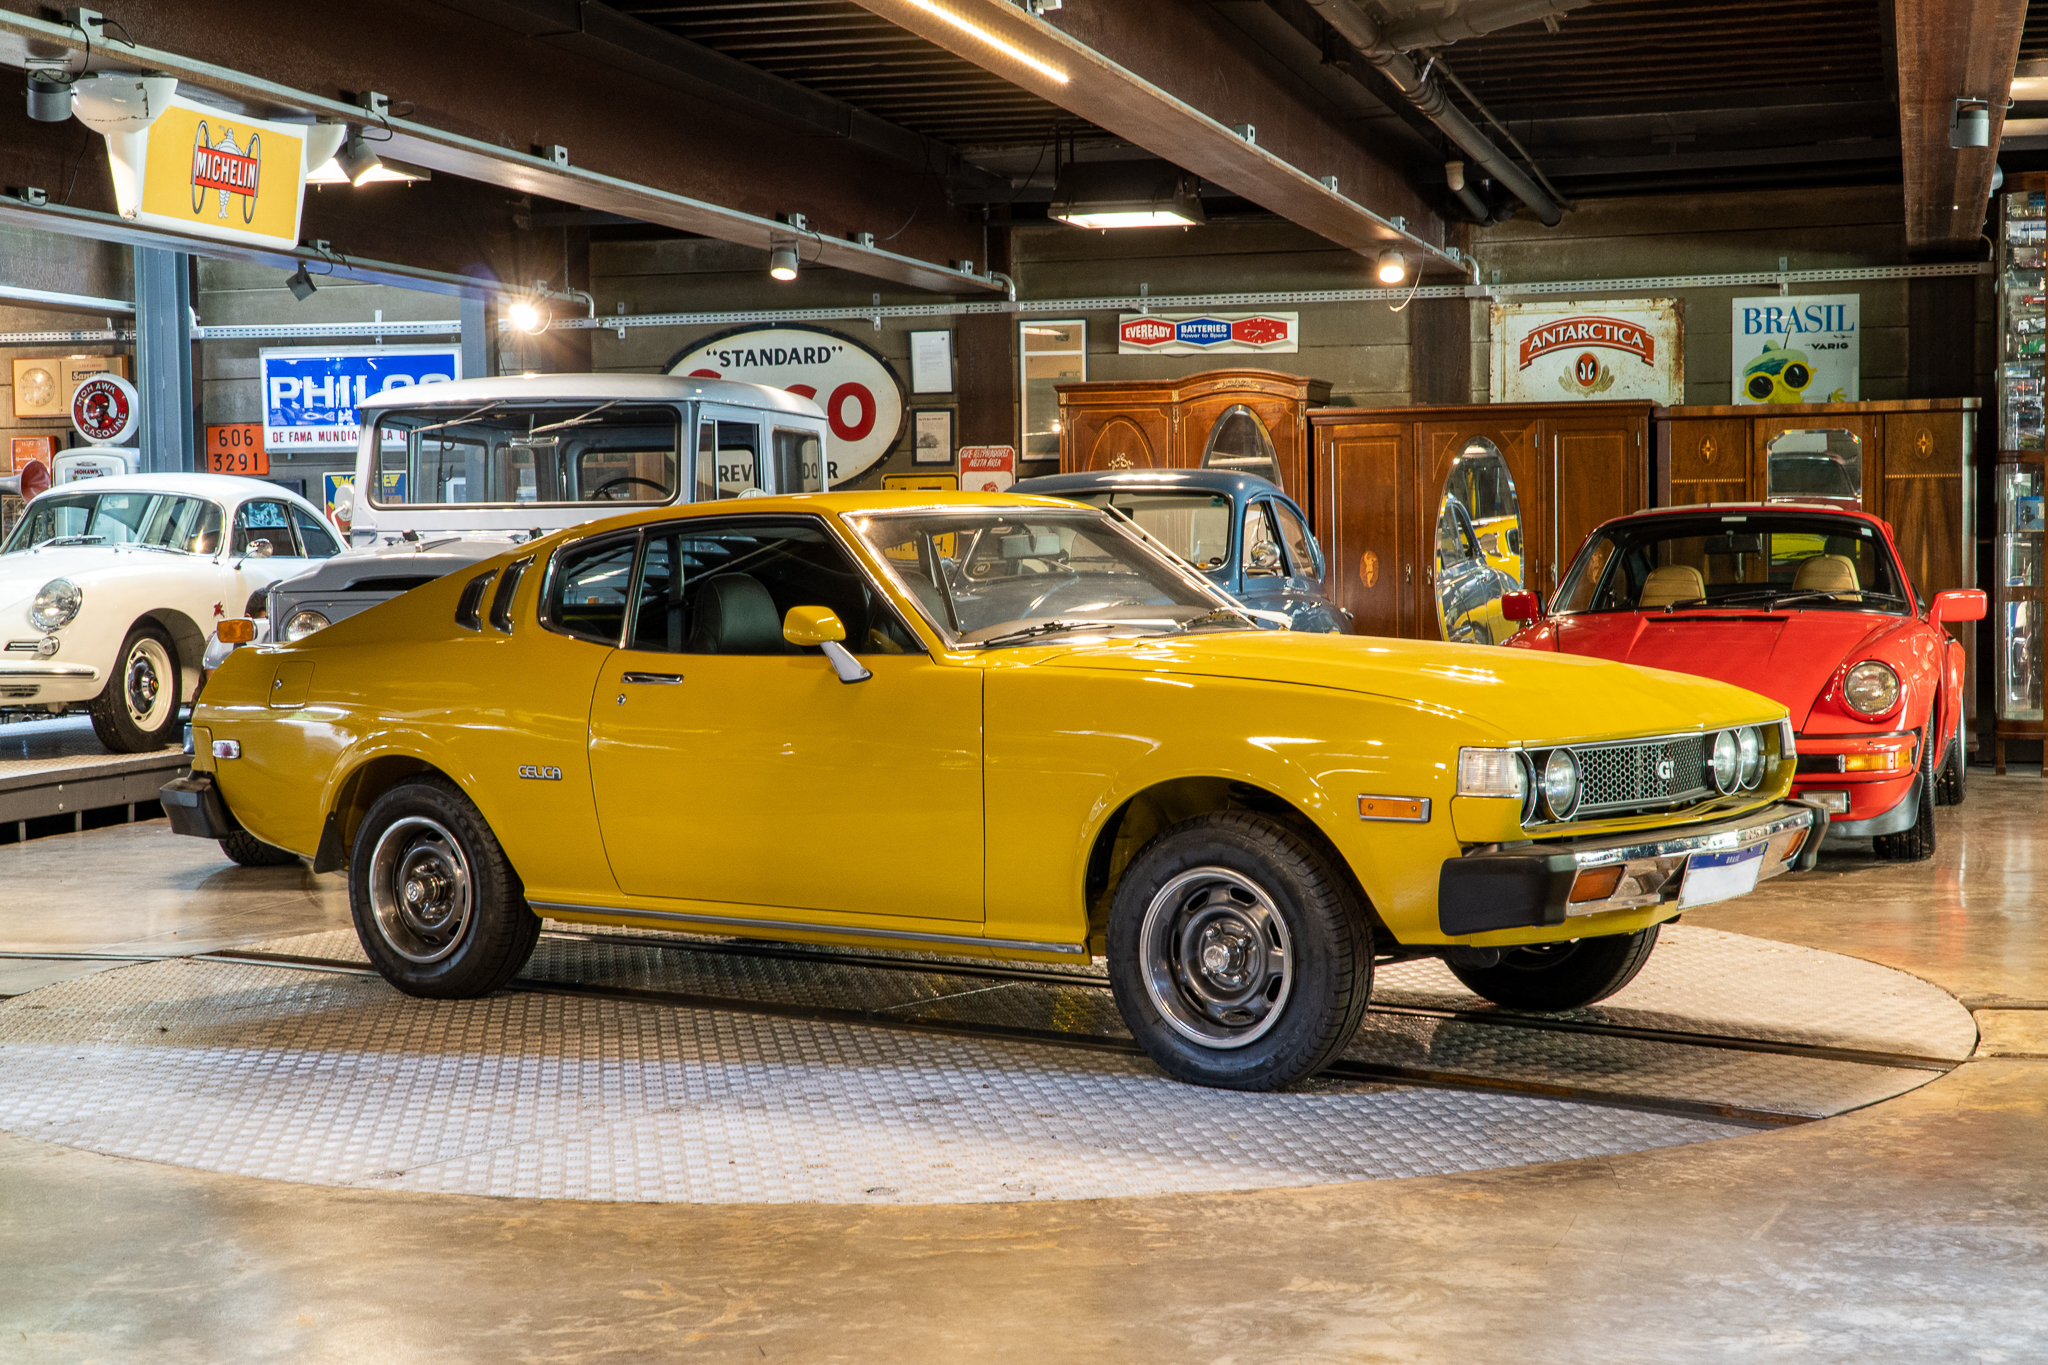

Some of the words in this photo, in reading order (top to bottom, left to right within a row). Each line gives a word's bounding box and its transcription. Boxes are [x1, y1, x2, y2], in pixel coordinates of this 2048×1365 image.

[195, 151, 257, 191] MICHELIN
[1180, 324, 1227, 333] BATTERIES
[1742, 304, 1855, 335] BRASIL
[1125, 323, 1171, 338] EVEREADY
[1529, 323, 1645, 353] ANTARCTICA
[1811, 342, 1849, 350] VARIG
[83, 412, 126, 438] GASOLINE
[219, 428, 253, 447] 606
[273, 432, 284, 443] DE
[289, 431, 313, 442] FAMA
[214, 453, 258, 472] 3291
[518, 765, 562, 780] CELICA
